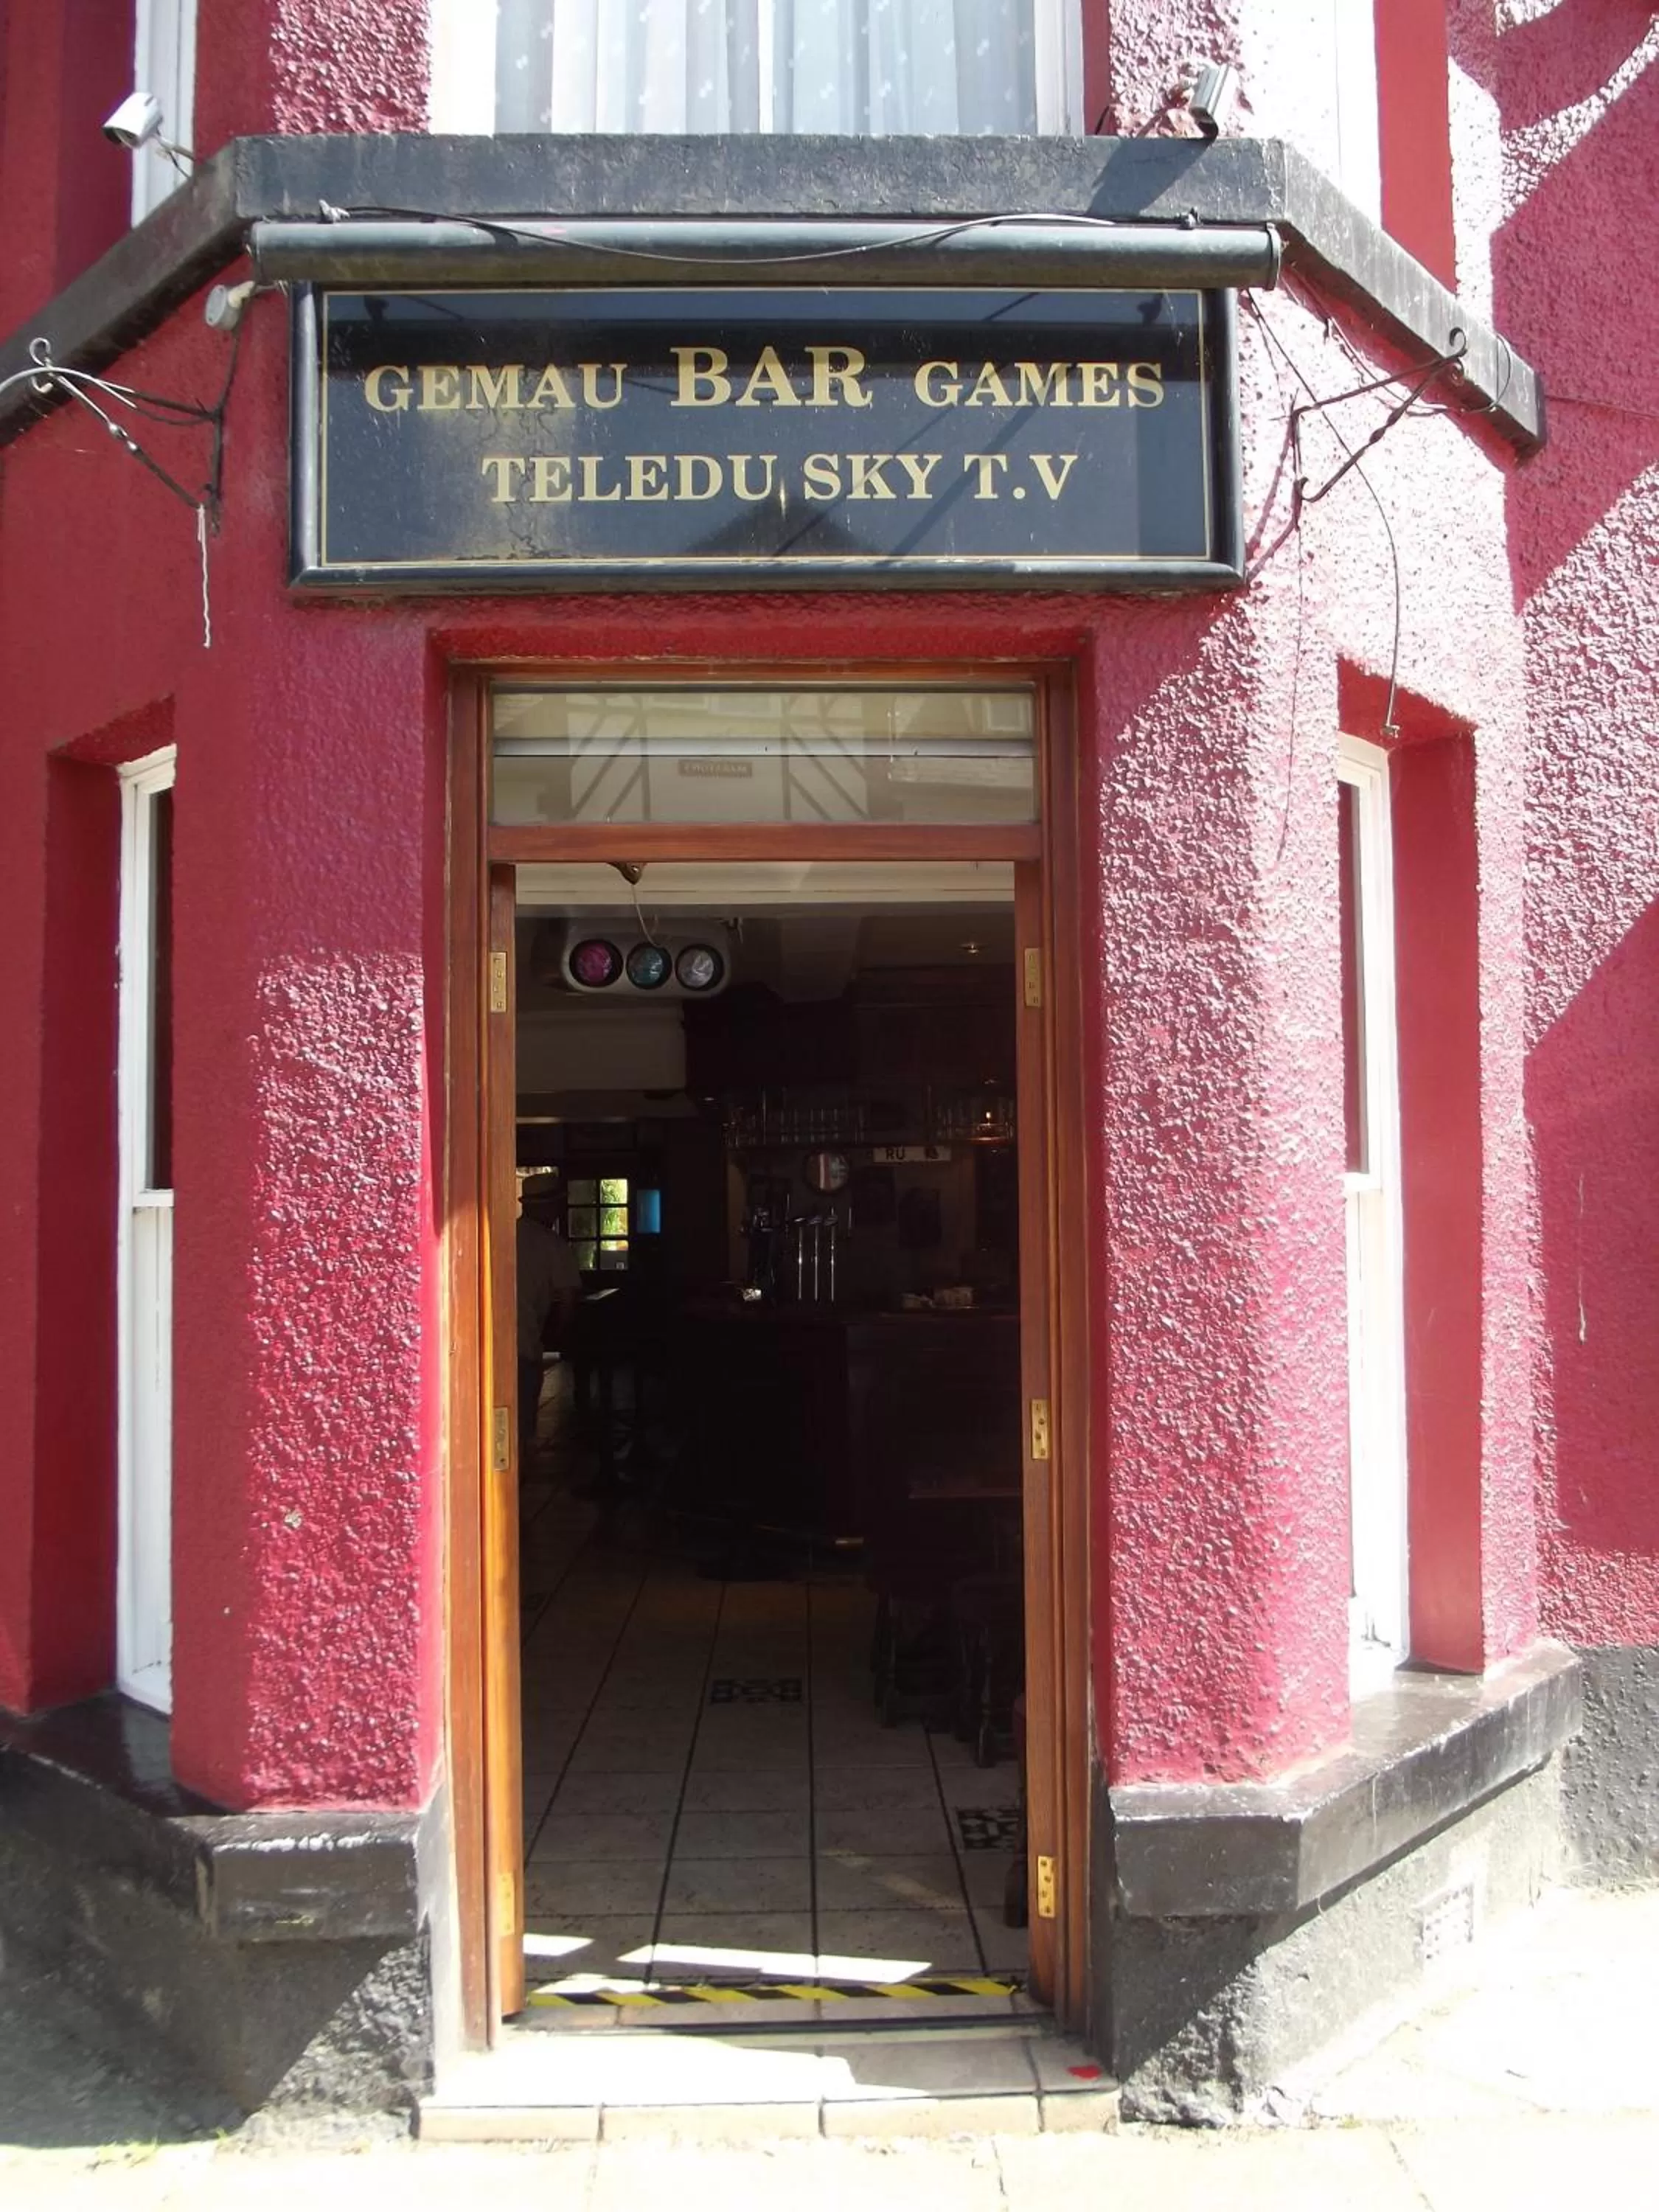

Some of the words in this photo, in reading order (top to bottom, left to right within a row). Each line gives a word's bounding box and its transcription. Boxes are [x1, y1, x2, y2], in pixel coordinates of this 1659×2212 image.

[364, 363, 628, 412] GEMAU
[669, 346, 873, 407] BAR
[914, 361, 1164, 408] GAMES
[481, 454, 778, 502] TELEDU
[803, 453, 942, 500] SKY
[964, 454, 1078, 500] T.V
